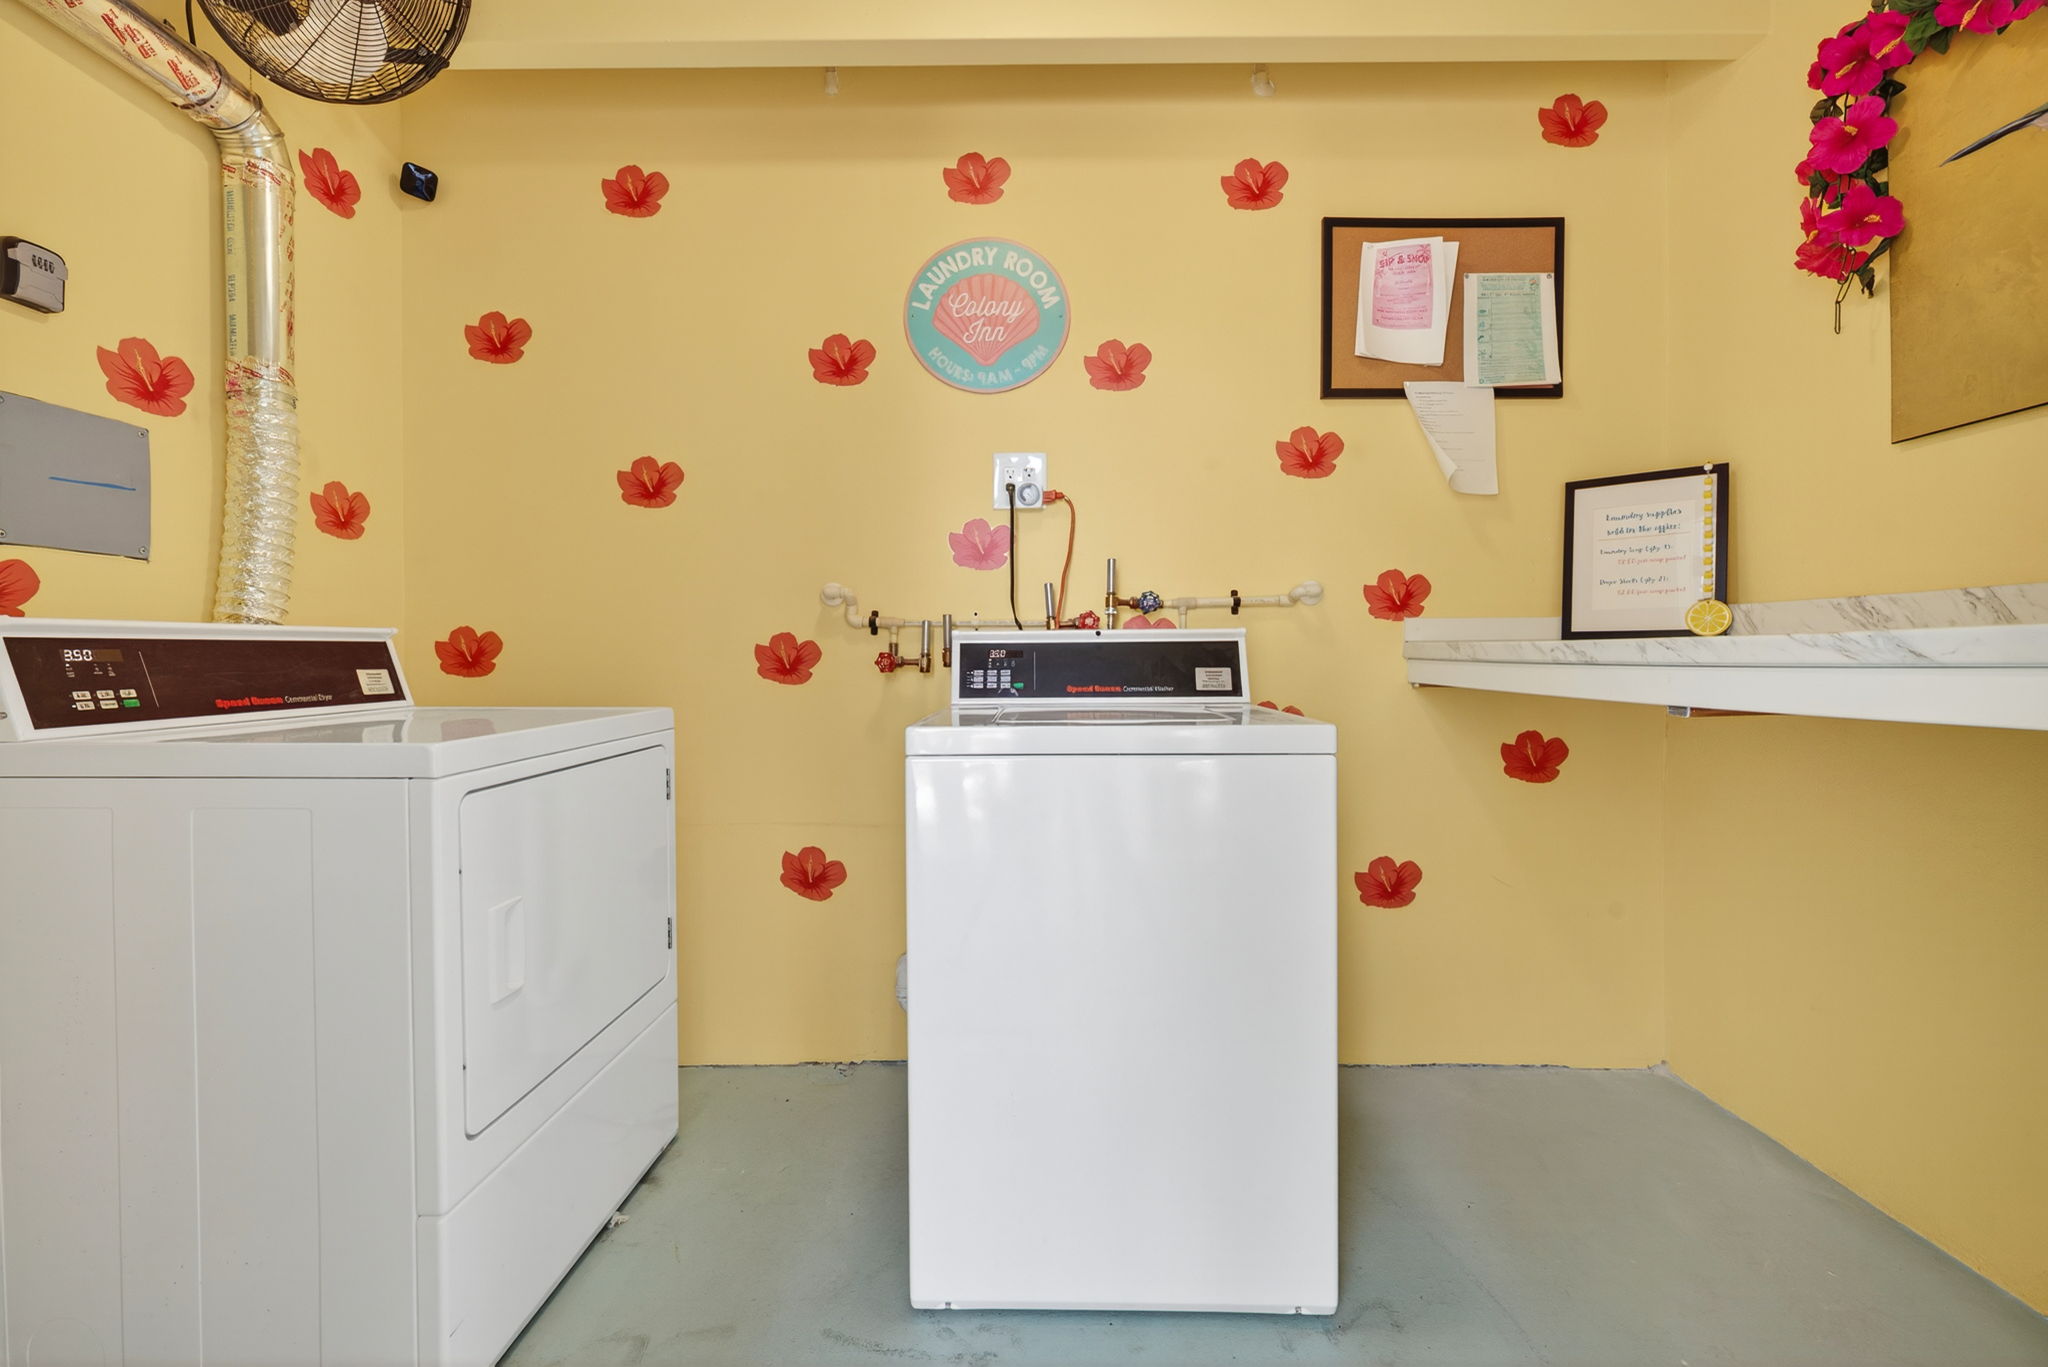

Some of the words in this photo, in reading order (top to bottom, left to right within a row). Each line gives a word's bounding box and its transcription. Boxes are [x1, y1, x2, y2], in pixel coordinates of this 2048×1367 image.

[1397, 254, 1405, 265] &
[912, 246, 998, 310] LAUNDRY
[1003, 250, 1060, 310] ROOM
[948, 292, 1024, 323] Colony
[963, 318, 1007, 344] Inn
[977, 367, 1014, 385] 9AM
[1021, 344, 1050, 369] 9PM
[1606, 511, 1643, 521] Laundry
[1066, 685, 1093, 694] Speed
[215, 697, 250, 710] Speed
[251, 696, 283, 706] Queen
[284, 694, 317, 704] Commercial
